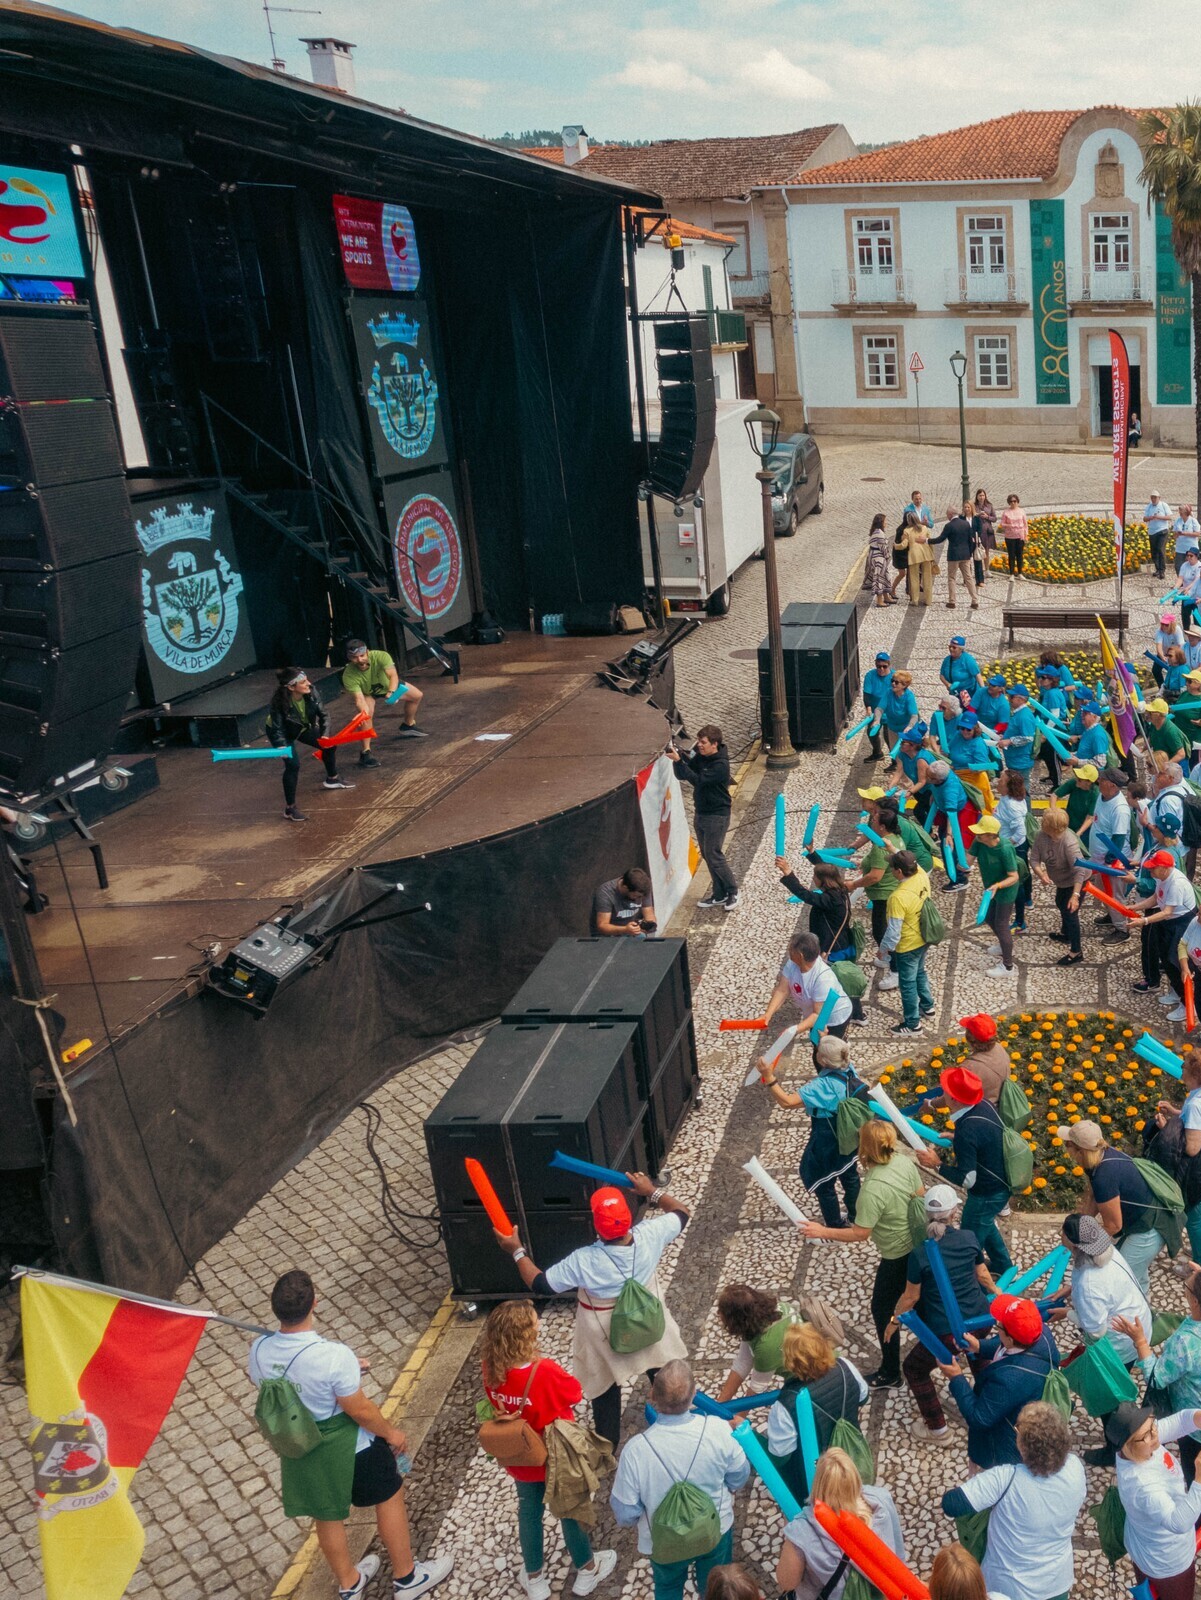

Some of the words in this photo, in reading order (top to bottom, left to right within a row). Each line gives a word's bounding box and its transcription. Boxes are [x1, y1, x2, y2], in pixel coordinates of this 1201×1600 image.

[341, 234, 354, 247] WE
[354, 236, 369, 249] ARE
[344, 251, 373, 265] SPORTS
[1053, 260, 1065, 305] ANOS
[435, 510, 446, 523] WE
[400, 503, 432, 572] INTERMUNICIPAL
[444, 522, 455, 539] ARE
[449, 545, 459, 589] SPORTS
[428, 596, 447, 611] WAS
[165, 645, 188, 669] VILA
[190, 657, 203, 669] DE
[205, 628, 234, 666] MURÇA
